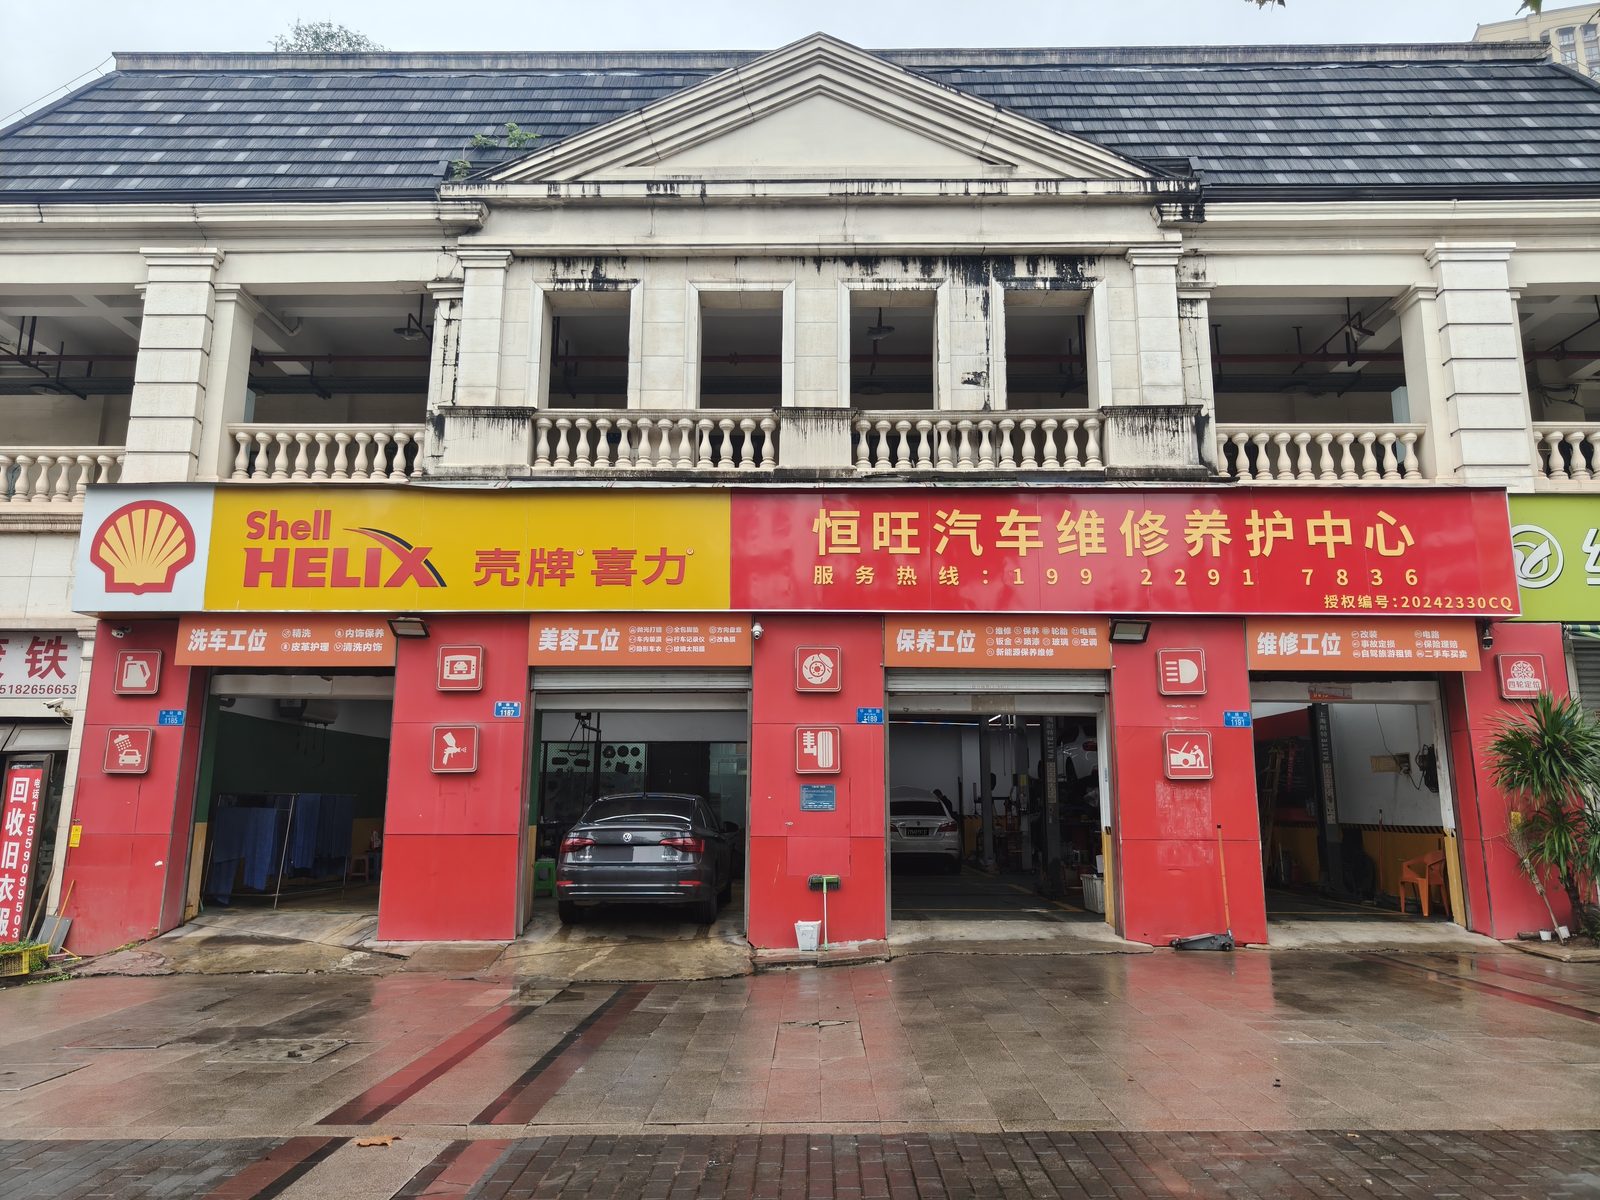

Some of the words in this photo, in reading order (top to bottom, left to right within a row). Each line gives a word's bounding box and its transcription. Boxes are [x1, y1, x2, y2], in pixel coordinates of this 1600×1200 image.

[246, 509, 332, 541] Shell
[812, 508, 1415, 559] 恒旺汽车维修养护中心
[243, 540, 444, 588] HELIX
[188, 628, 268, 652] 洗车工位
[345, 628, 384, 638] 内饰保养
[538, 627, 620, 652] 美容工位
[896, 628, 976, 653] 保养工位
[1257, 632, 1341, 656] 维修工位
[291, 642, 330, 652] 皮革护理
